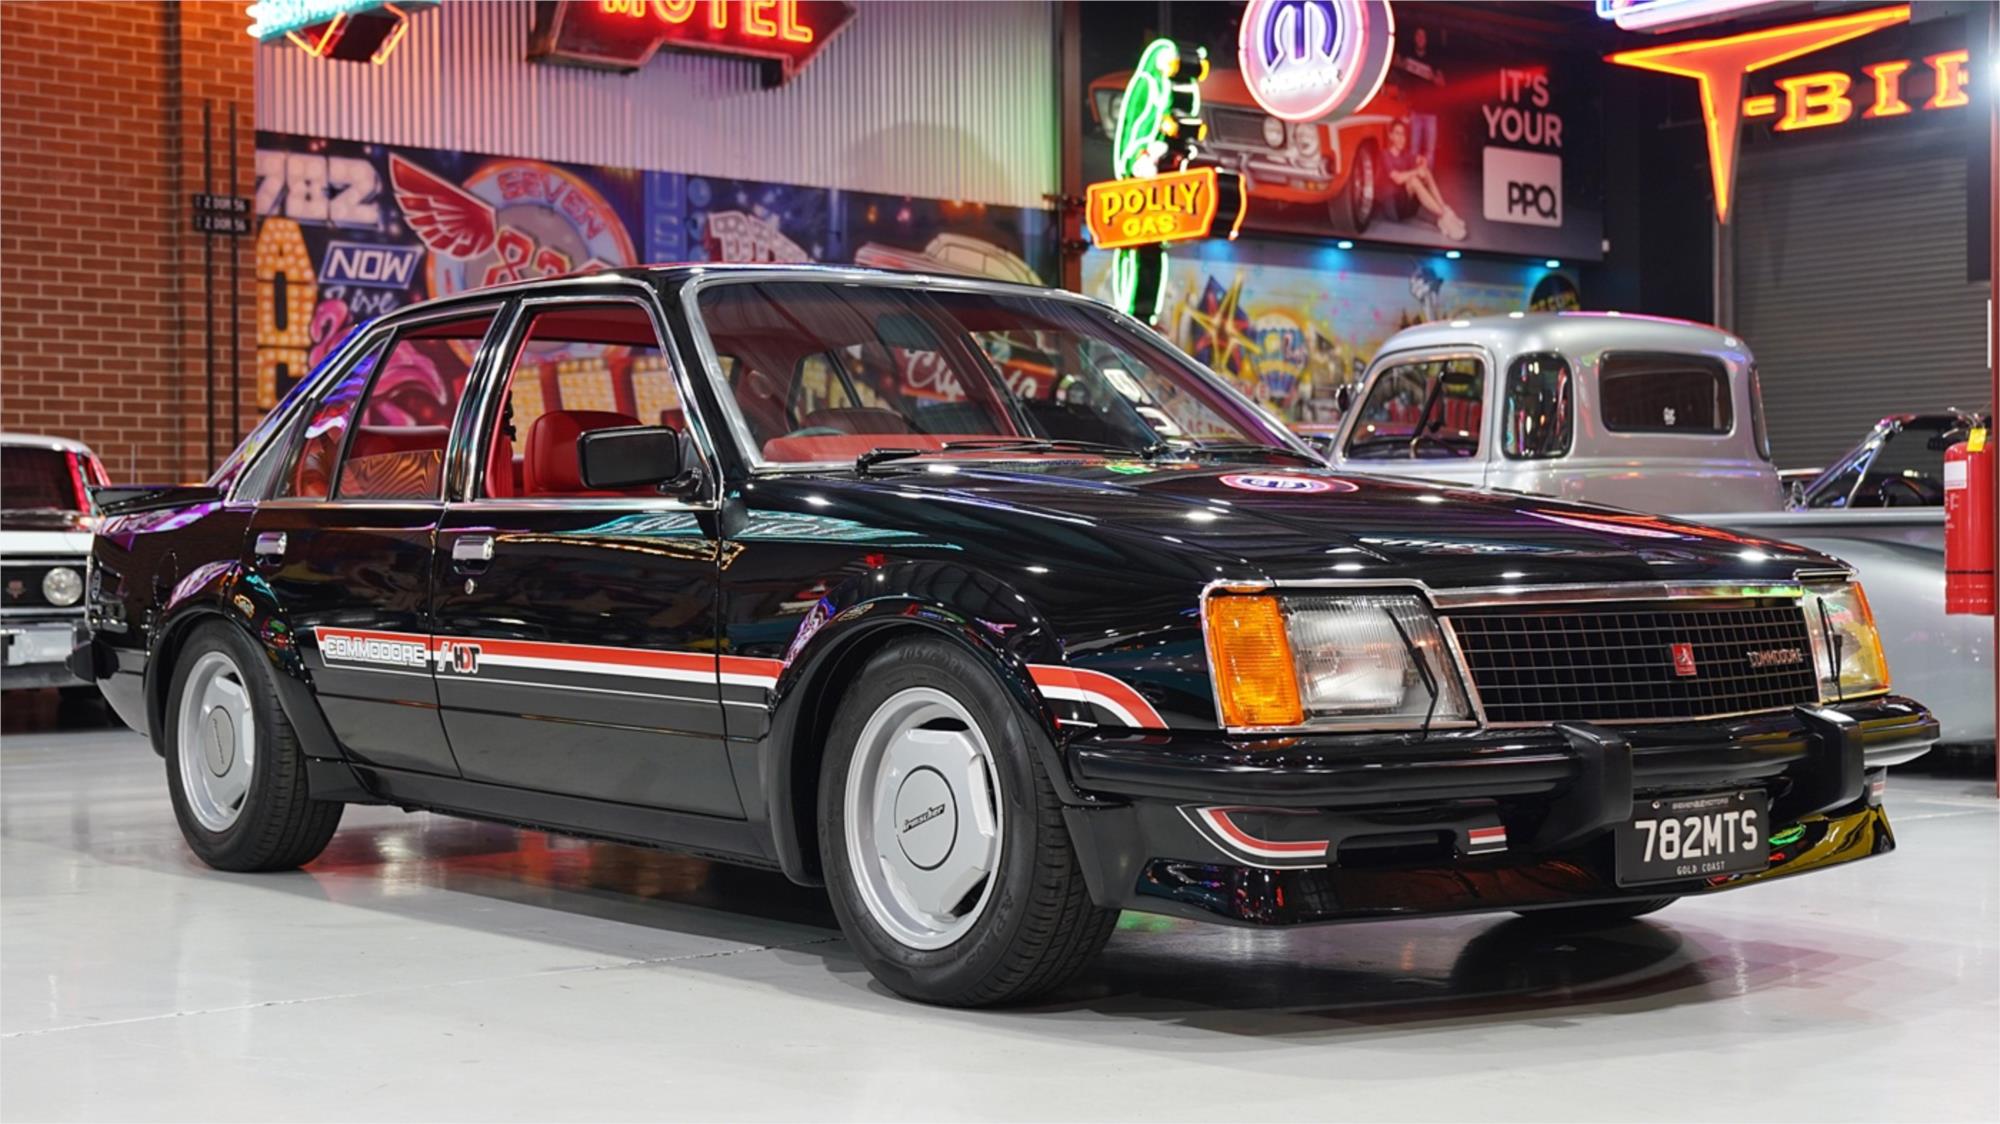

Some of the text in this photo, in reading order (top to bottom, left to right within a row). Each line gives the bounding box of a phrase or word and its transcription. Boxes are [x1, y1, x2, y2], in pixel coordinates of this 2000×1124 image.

[1501, 68, 1549, 107] IT'S
[1482, 104, 1563, 147] YOUR
[255, 150, 379, 227] 782
[497, 170, 605, 240] SEVEN
[1101, 180, 1202, 225] POLLY
[1507, 181, 1558, 220] PPQ
[1122, 213, 1176, 237] GAS
[327, 249, 413, 284] NOW
[325, 635, 427, 667] COMMODORE
[454, 644, 481, 672] HDT
[1635, 809, 1759, 862] 782MTS
[1676, 861, 1726, 876] GOLD COAST
